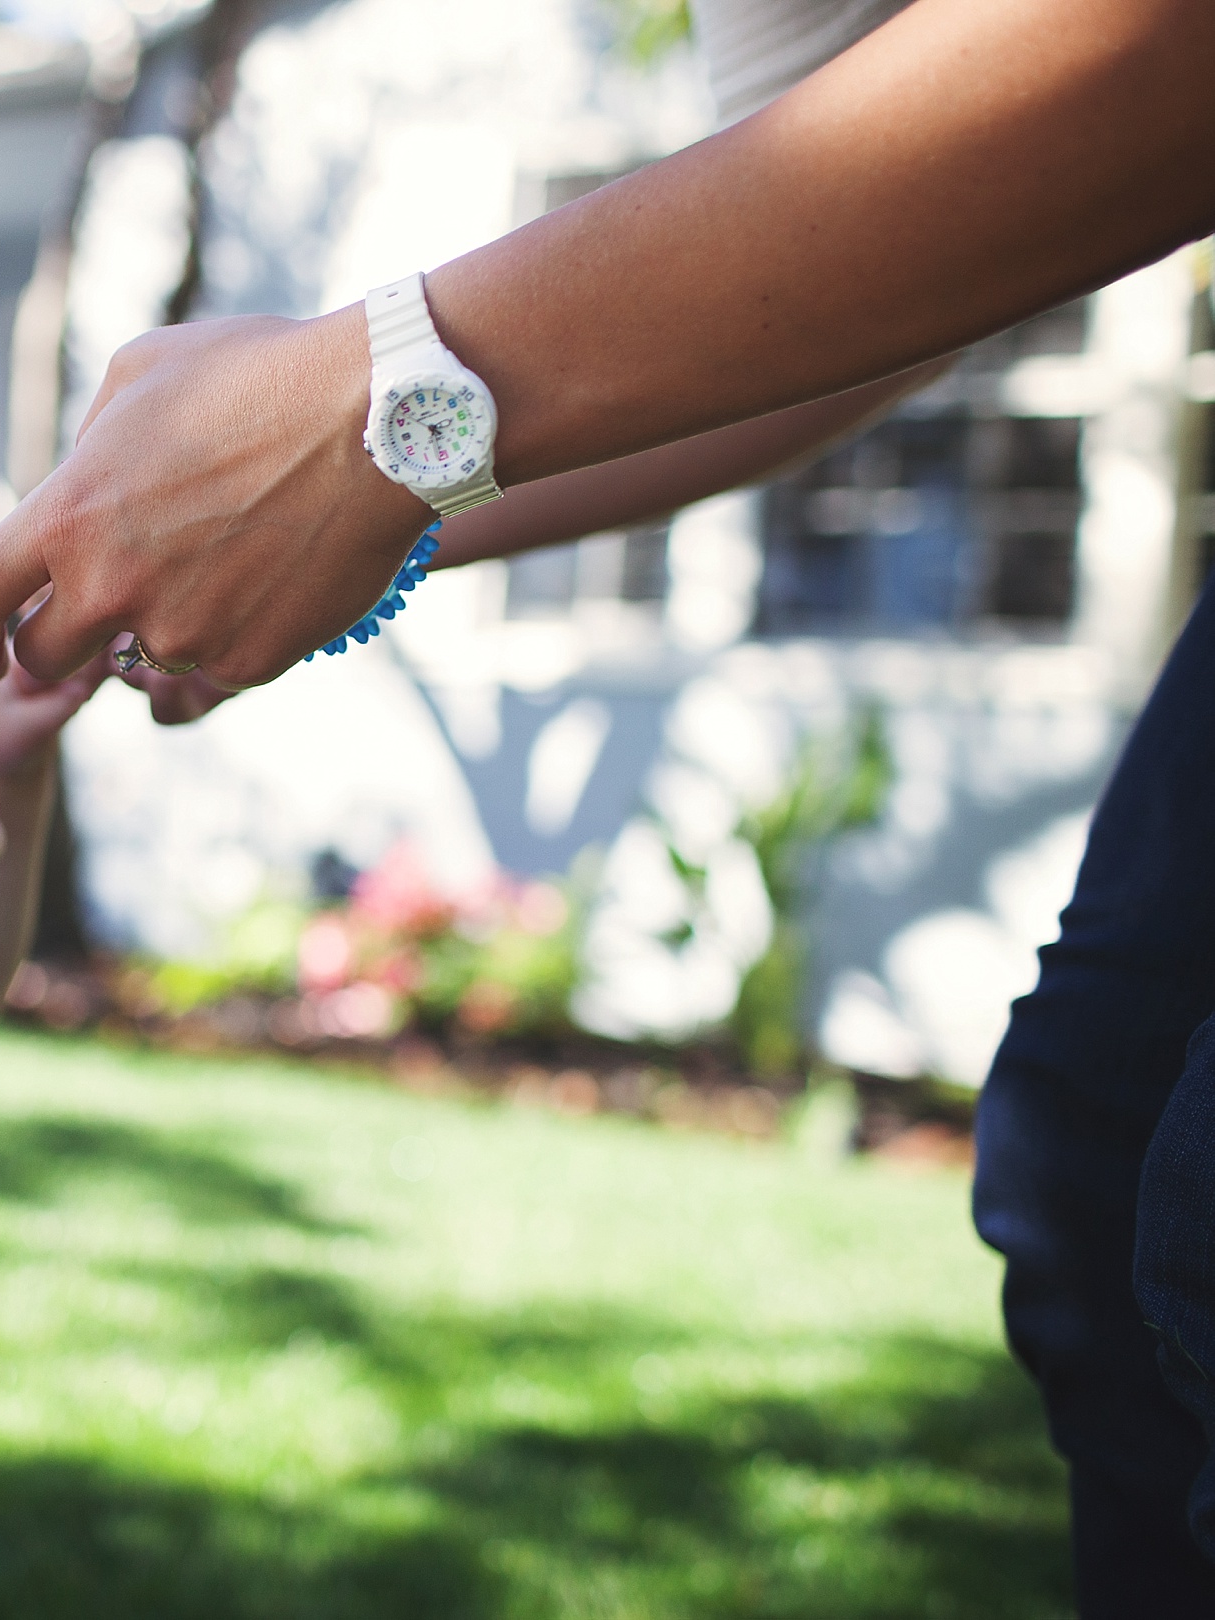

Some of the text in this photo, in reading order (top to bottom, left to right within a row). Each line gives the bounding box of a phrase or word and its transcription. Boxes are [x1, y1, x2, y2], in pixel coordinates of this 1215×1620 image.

[415, 393, 426, 404] 6
[433, 388, 441, 401] 7
[458, 385, 475, 401] 30
[400, 402, 411, 414] 5
[447, 397, 458, 409] 8
[396, 418, 405, 427] 4
[405, 445, 415, 456] 2
[460, 458, 475, 474] 45
